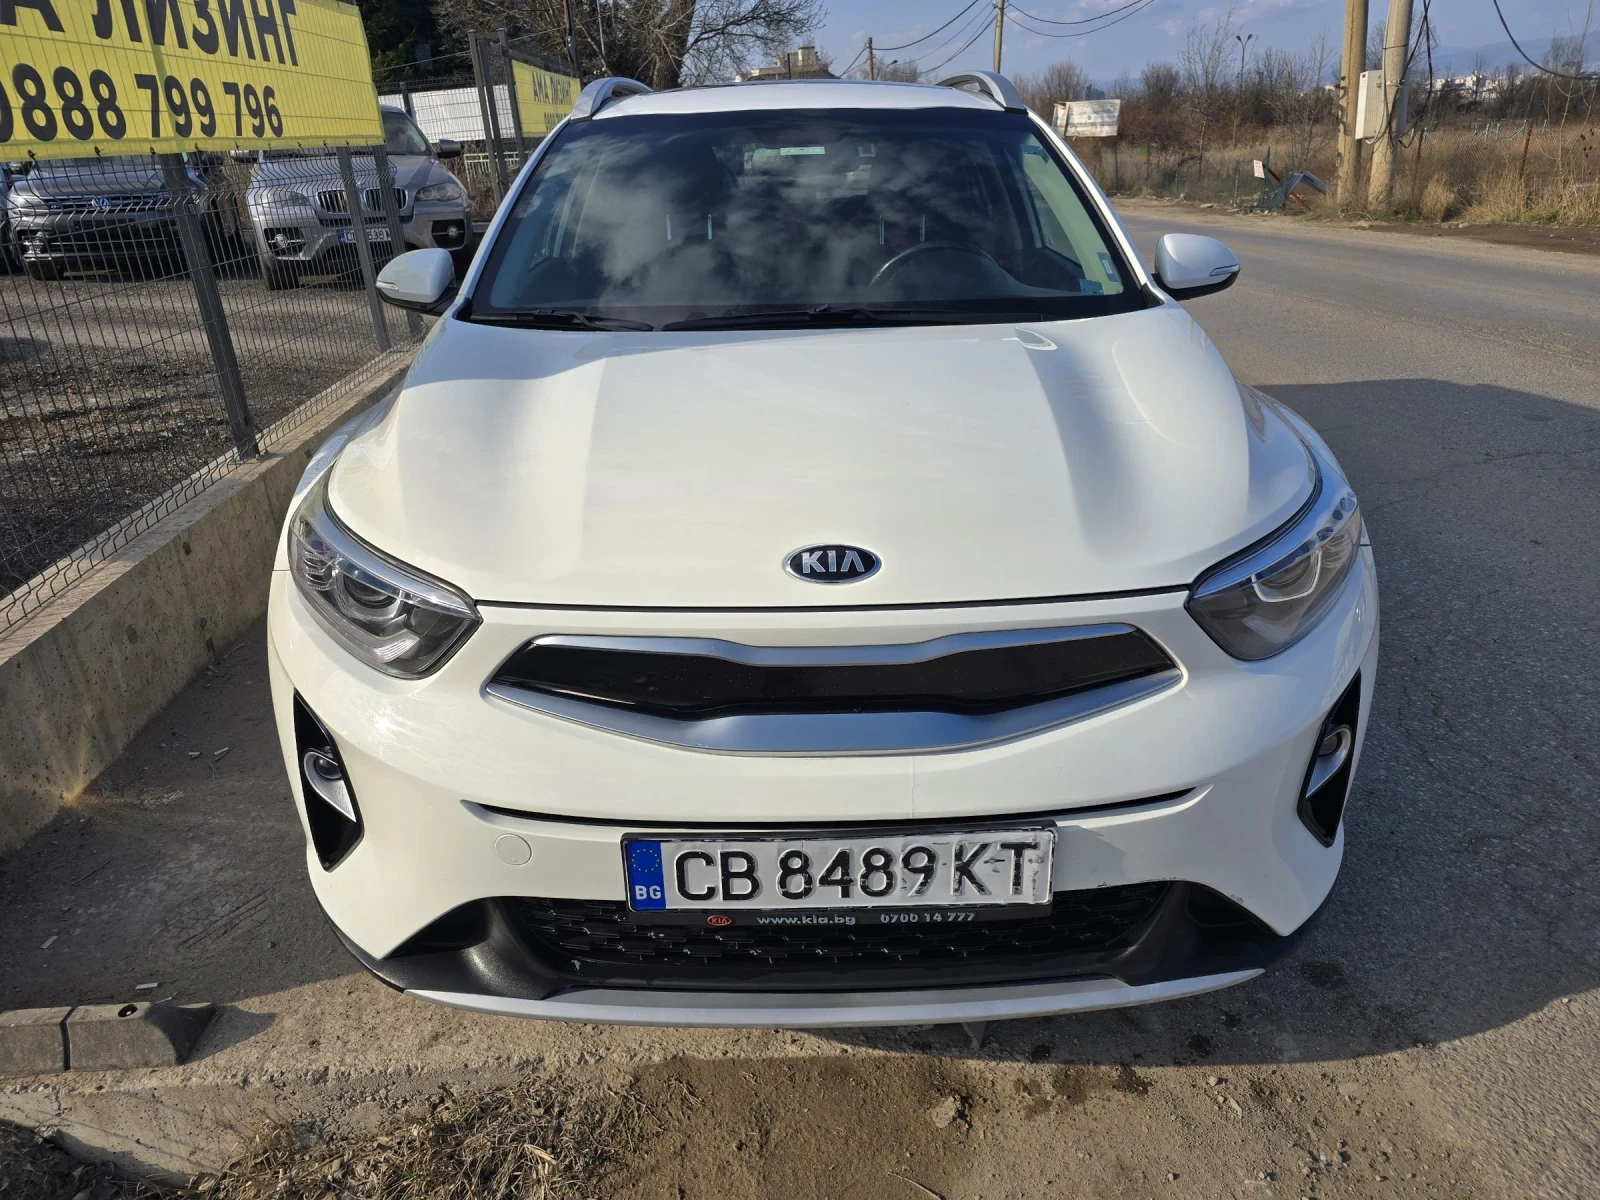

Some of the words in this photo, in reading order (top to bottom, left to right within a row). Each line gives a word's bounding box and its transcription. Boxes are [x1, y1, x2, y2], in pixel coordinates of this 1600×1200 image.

[0, 62, 127, 142] 888
[134, 73, 217, 138] 799
[222, 81, 284, 138] 796
[801, 550, 865, 574] KIA
[674, 849, 760, 902] CB
[775, 846, 937, 901] 8489
[949, 839, 1041, 897] KT
[634, 884, 662, 901] BG
[708, 915, 731, 926] KIA
[756, 913, 857, 926] www.kia.bg
[880, 912, 919, 924] 0700
[924, 911, 943, 923] 14
[947, 911, 976, 922] 777
